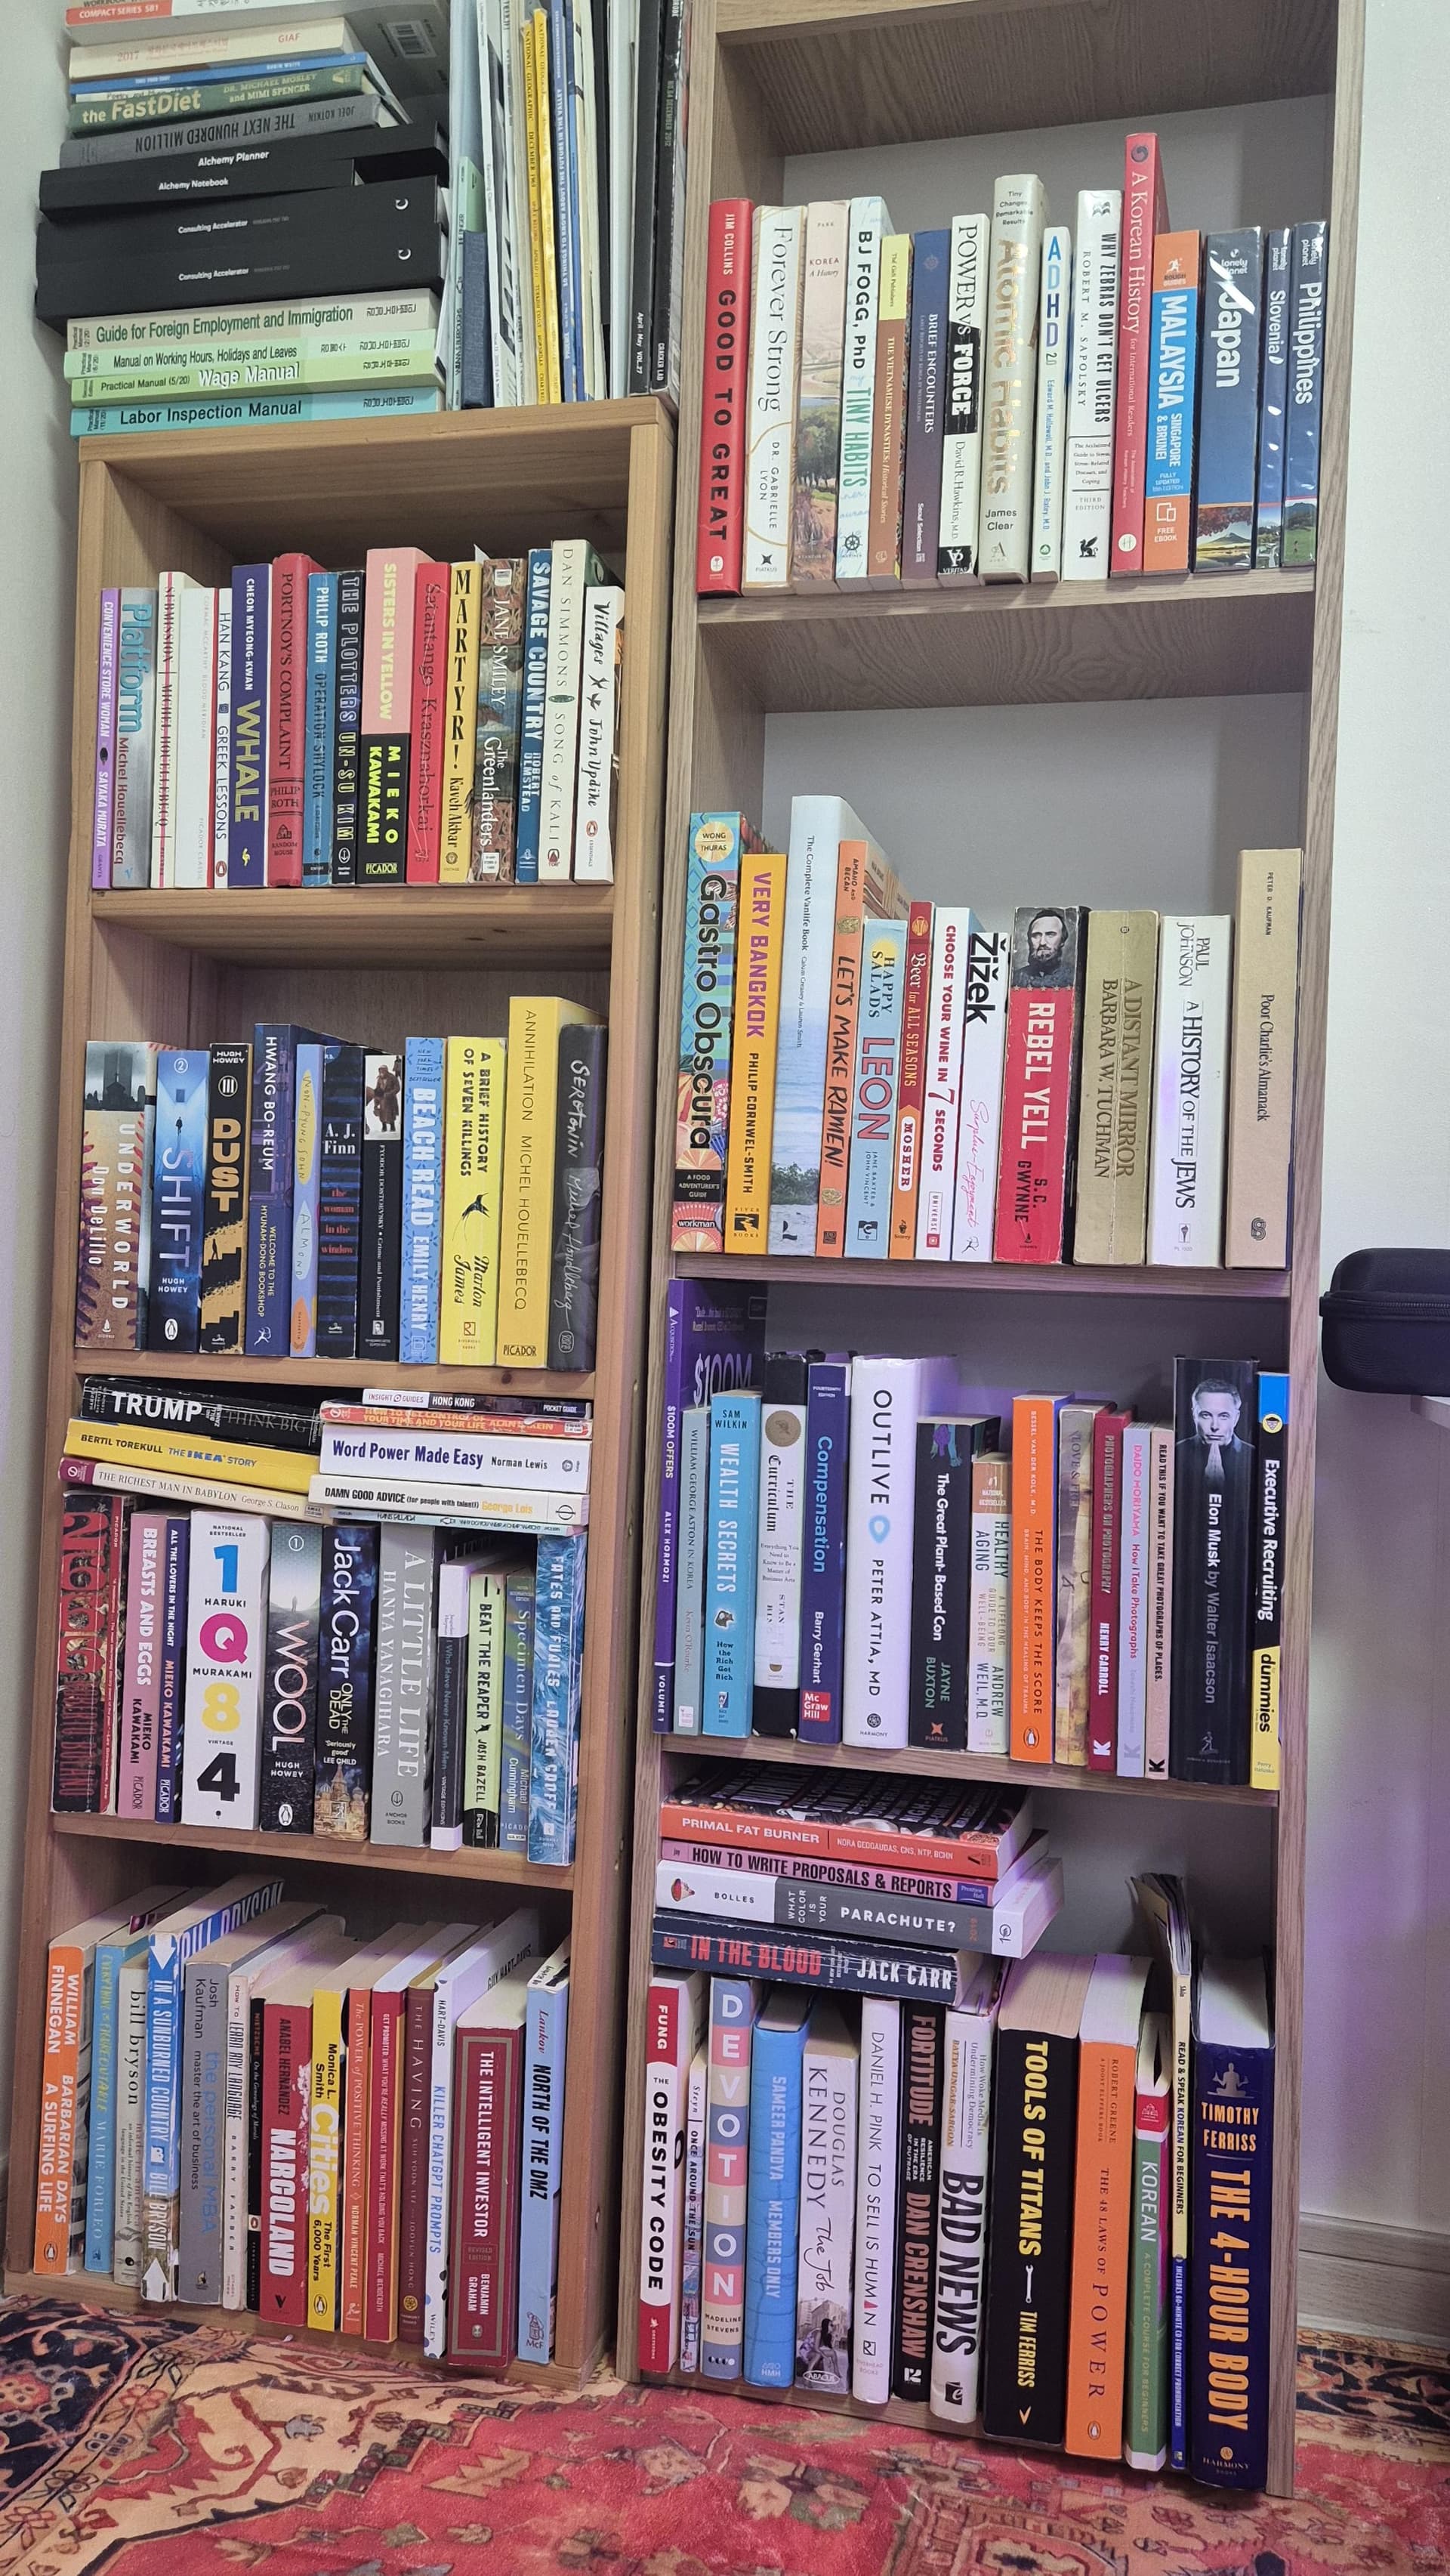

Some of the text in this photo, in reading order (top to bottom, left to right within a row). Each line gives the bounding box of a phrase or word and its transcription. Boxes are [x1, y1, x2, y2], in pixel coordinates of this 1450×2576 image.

[82, 90, 202, 125] the FastDiet
[135, 113, 296, 153] THE NEXT HUNDRED MILLION
[159, 178, 228, 190] Alchemy Notebook
[198, 151, 270, 167] Alchemy Planner
[178, 223, 211, 233] Consulting
[213, 219, 248, 230] Accelerator
[723, 214, 735, 275] JIM COLLINS
[96, 305, 353, 344] Guide for Foreign Employment and Immigration
[852, 230, 872, 369] BJ FOGG, PhD
[1094, 233, 1116, 423] WHY ZEBRAS DON'T GET ULCERS
[1158, 295, 1185, 409] MALAYSIA
[120, 400, 302, 425] Labor Inspection Manual
[710, 290, 736, 541] GOOD TO GREAT
[843, 387, 871, 489] TINY HABITS
[986, 508, 1017, 521] James
[986, 520, 1013, 532] Clear
[1154, 535, 1177, 543] EBOOK
[245, 579, 255, 690] CHEON MYEONG-KWAN
[315, 587, 329, 663] PHILIP ROTH
[381, 563, 396, 721] SISTERS IN YELLOW
[216, 613, 230, 840] HAN KANG GREEK LESSONS
[235, 701, 261, 823] WHALE
[582, 719, 603, 808] John Updike
[366, 746, 382, 843] KAWAKAMI
[386, 745, 401, 843] MIEKO
[701, 844, 727, 852] THURAS
[702, 832, 726, 840] WONG
[366, 862, 398, 874] PICADOR
[746, 872, 772, 1039] VERY BANGKOK
[868, 950, 883, 1018] SALADS
[966, 933, 1007, 1024] Žižek
[881, 956, 895, 1015] HAPPY
[928, 925, 956, 1172] CHOOSE YOUR WINE IN 7 SECONDS
[1020, 1001, 1056, 1149] REBEL YELL
[262, 1036, 277, 1171] HWANG BO-REUM
[858, 1036, 895, 1140] LEON
[324, 1140, 356, 1155] Finn
[325, 1123, 355, 1139] A. J.
[742, 1052, 759, 1194] PHILIP CORNWEL-SMITH
[211, 1119, 241, 1212] DUST
[410, 1088, 437, 1226] BEACH READ
[677, 1219, 715, 1229] workman
[158, 1285, 188, 1293] HOWEY
[503, 1344, 537, 1357] PICADOR
[112, 1391, 202, 1422] TRUMP
[432, 1396, 474, 1407] HONG KONG
[714, 1419, 748, 1429] WILKIN
[722, 1410, 742, 1419] SAM
[333, 1440, 483, 1469] Word Power Made Easy
[492, 1456, 548, 1470] Norman Lewis
[871, 1389, 893, 1505] OUTLIVE
[716, 1443, 739, 1592] WEALTH SECRETS
[1257, 1459, 1280, 1621] Executive Recruiting
[214, 1544, 239, 1592] 1
[205, 1598, 246, 1608] HARUKI
[868, 1559, 884, 1697] PETER ATTIA, MD
[199, 1613, 248, 1663] Q
[810, 1611, 825, 1684] Barry Gerhart
[193, 1668, 252, 1679] MURAKAMI
[658, 1674, 666, 1713] VOLUME
[924, 1657, 936, 1709] BUXTON
[940, 1662, 951, 1703] JAYNE
[1259, 1654, 1276, 1732] dummies
[202, 1682, 241, 1732] 8
[197, 1753, 240, 1802] 4
[683, 1817, 819, 1843] PRIMAL FAT BURNER
[714, 1892, 754, 1904] BOLLES
[841, 1906, 957, 1933] PARACHUTE?
[48, 1965, 65, 2054] FINNEGAN
[64, 1973, 79, 2045] WILLIAM
[657, 2005, 668, 2049] FUNG
[530, 2064, 551, 2200] NORTH OF THE DMZ
[1202, 2102, 1260, 2125] TIMOTHY
[1204, 2129, 1256, 2151] FERRISS
[474, 2051, 494, 2238] THE INTELLIGENT INVESTOR
[1019, 2041, 1048, 2257] TOOLS OF TITANS
[269, 2128, 298, 2277] NARCOLAND
[648, 2092, 668, 2290] OBESITY CODE
[1141, 2161, 1158, 2242] KOREAN
[936, 2170, 983, 2355] BAD NEWS
